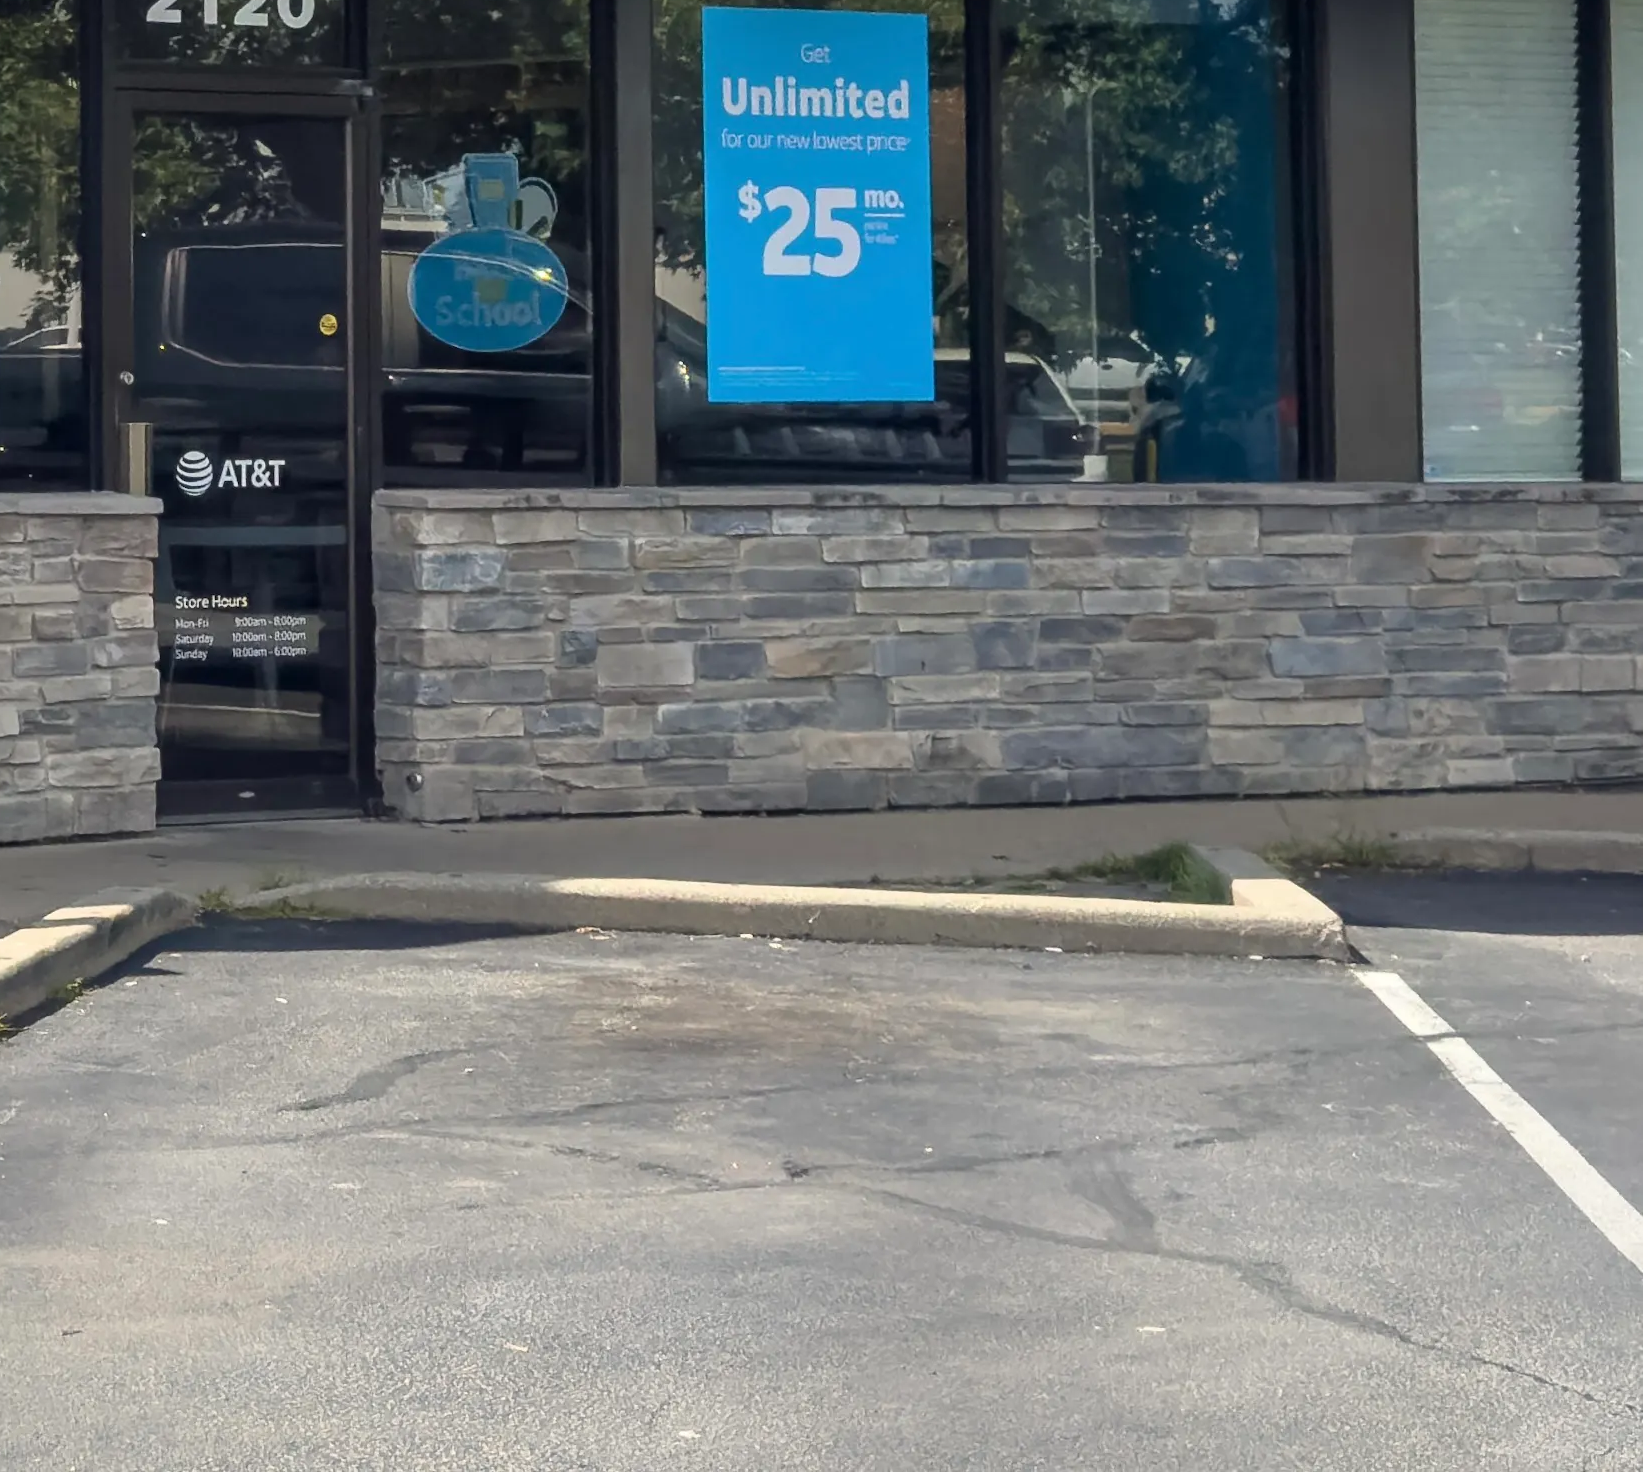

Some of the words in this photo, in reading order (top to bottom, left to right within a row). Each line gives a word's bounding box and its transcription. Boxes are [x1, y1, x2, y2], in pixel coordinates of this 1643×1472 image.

[800, 44, 831, 63] Get
[722, 76, 910, 119] Unlimited
[721, 128, 742, 148] for
[747, 134, 773, 149] our
[777, 135, 810, 150] new
[813, 131, 863, 151] lowest
[738, 180, 861, 277] $25
[865, 189, 905, 208] mo.
[436, 290, 542, 327] School
[218, 459, 286, 487] AT&T
[175, 596, 209, 609] Store
[212, 595, 248, 608] Hours
[175, 618, 209, 630] Mon-Fri
[175, 634, 214, 646] Saturday
[232, 632, 267, 643] 10:00am
[274, 631, 306, 643] 8:00pm
[175, 649, 208, 661] Sunday
[274, 646, 306, 658] 6:00pm
